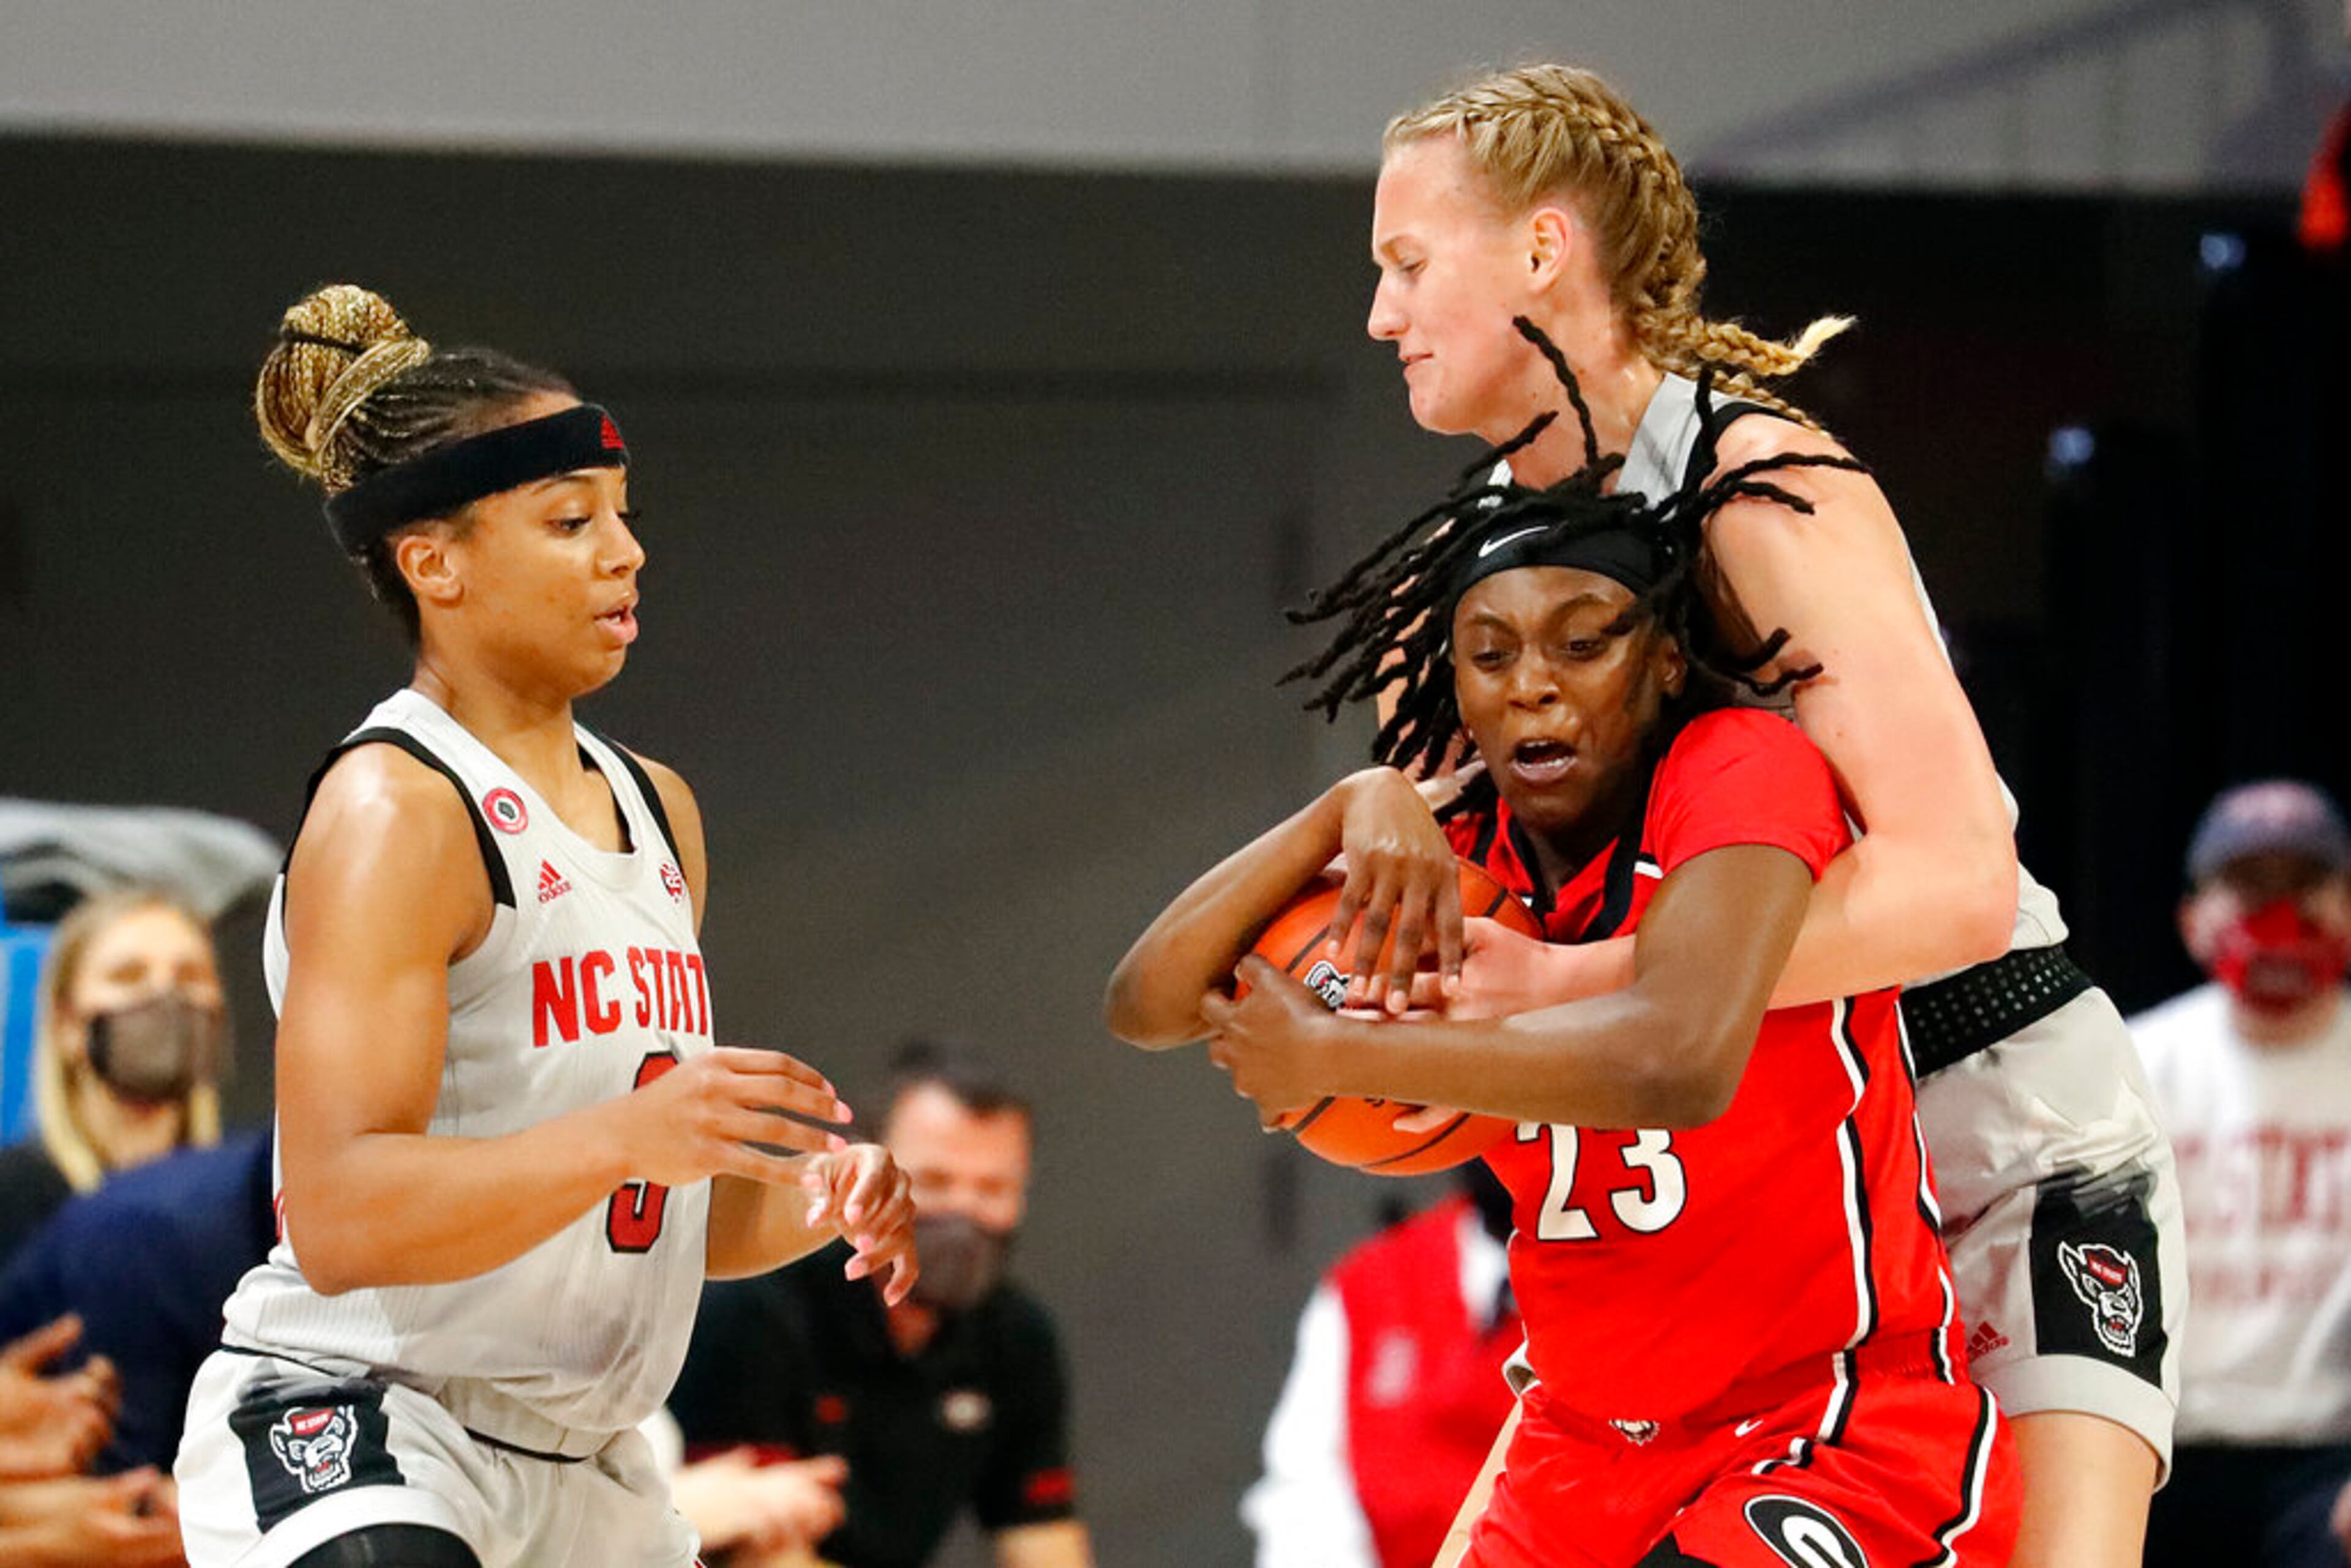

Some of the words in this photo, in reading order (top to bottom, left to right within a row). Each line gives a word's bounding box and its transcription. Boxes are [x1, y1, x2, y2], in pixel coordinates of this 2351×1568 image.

[532, 949, 621, 1048] NC
[627, 946, 707, 1036] STAT
[1516, 1121, 1688, 1242] 23
